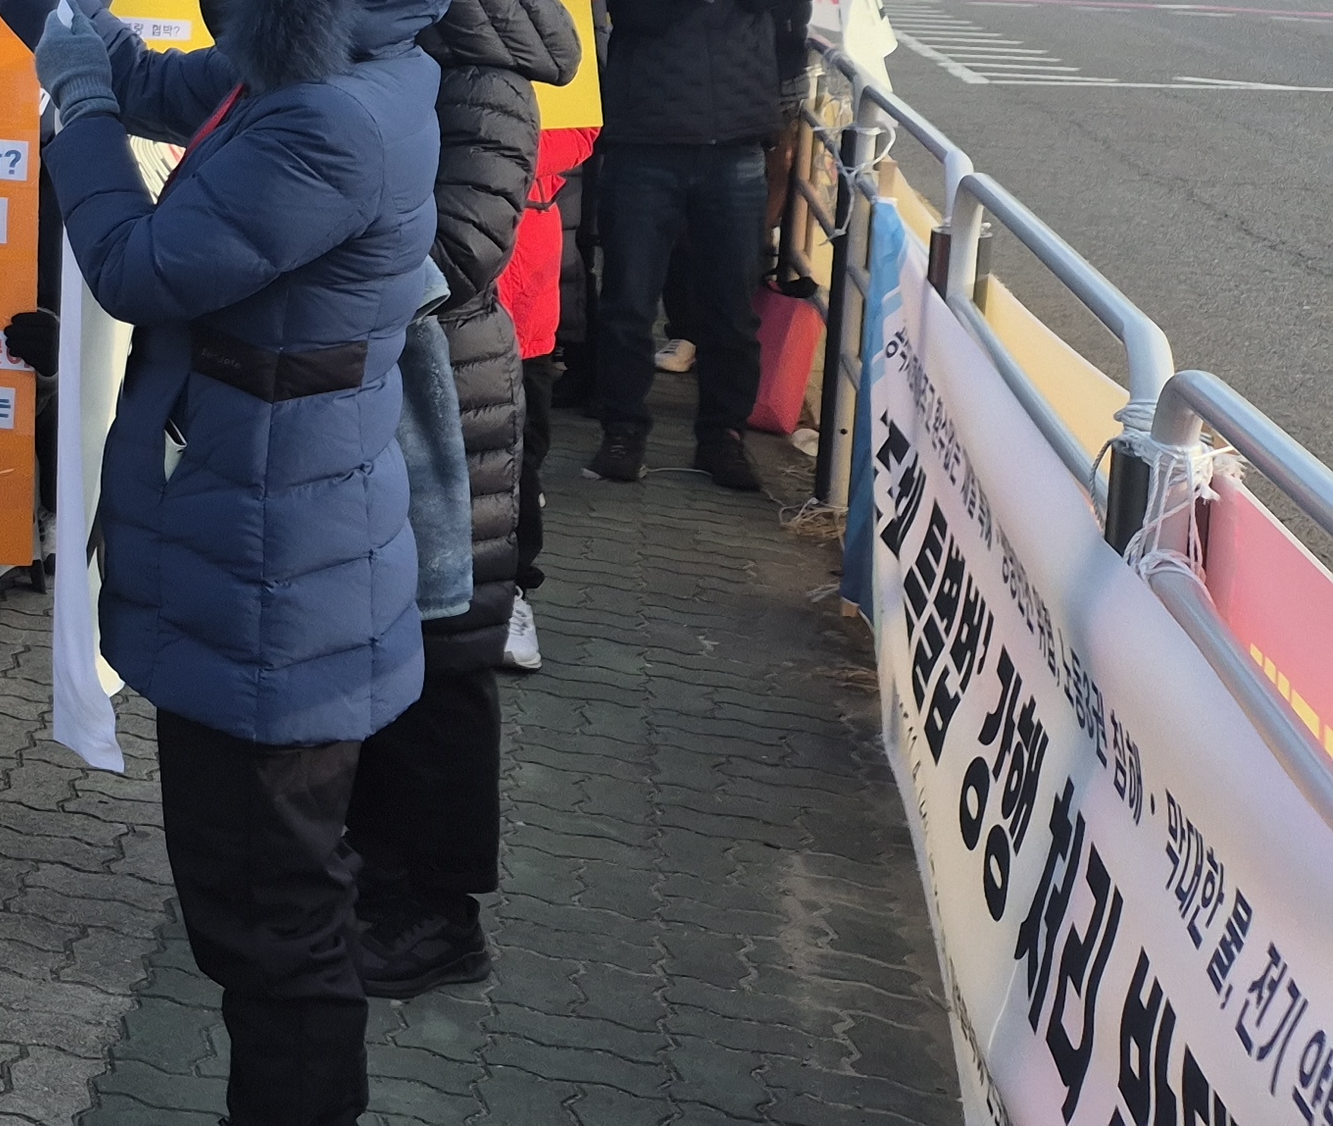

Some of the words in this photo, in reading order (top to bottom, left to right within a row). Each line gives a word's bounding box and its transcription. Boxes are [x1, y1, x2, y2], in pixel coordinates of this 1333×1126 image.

[959, 644, 1050, 923] 강행
[1014, 775, 1124, 1126] 처리
[1165, 787, 1225, 950] 막대한
[1206, 886, 1253, 1010] 물,
[1235, 940, 1309, 1098] 전기
